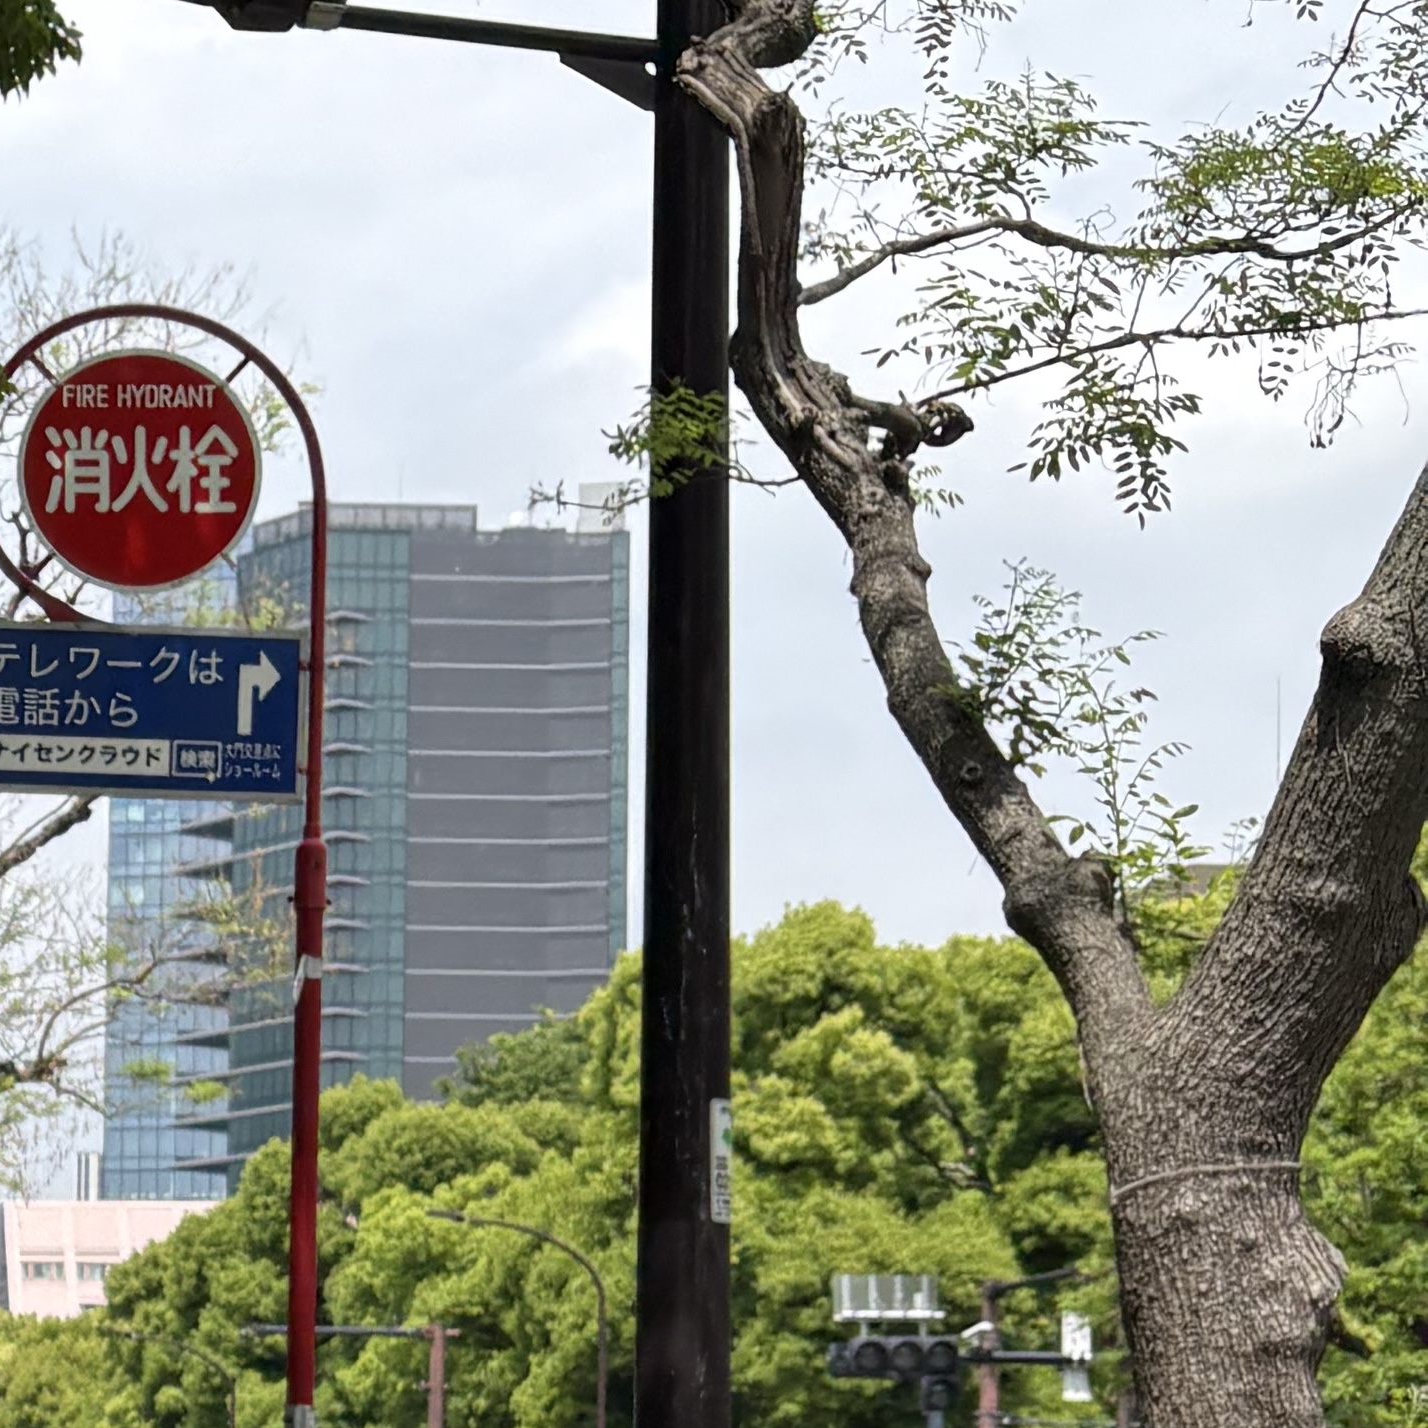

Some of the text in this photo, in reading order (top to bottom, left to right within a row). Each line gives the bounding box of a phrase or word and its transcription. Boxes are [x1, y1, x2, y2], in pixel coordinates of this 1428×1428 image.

[62, 384, 217, 409] FIRE HYDRANT
[45, 424, 239, 514] 消火栓
